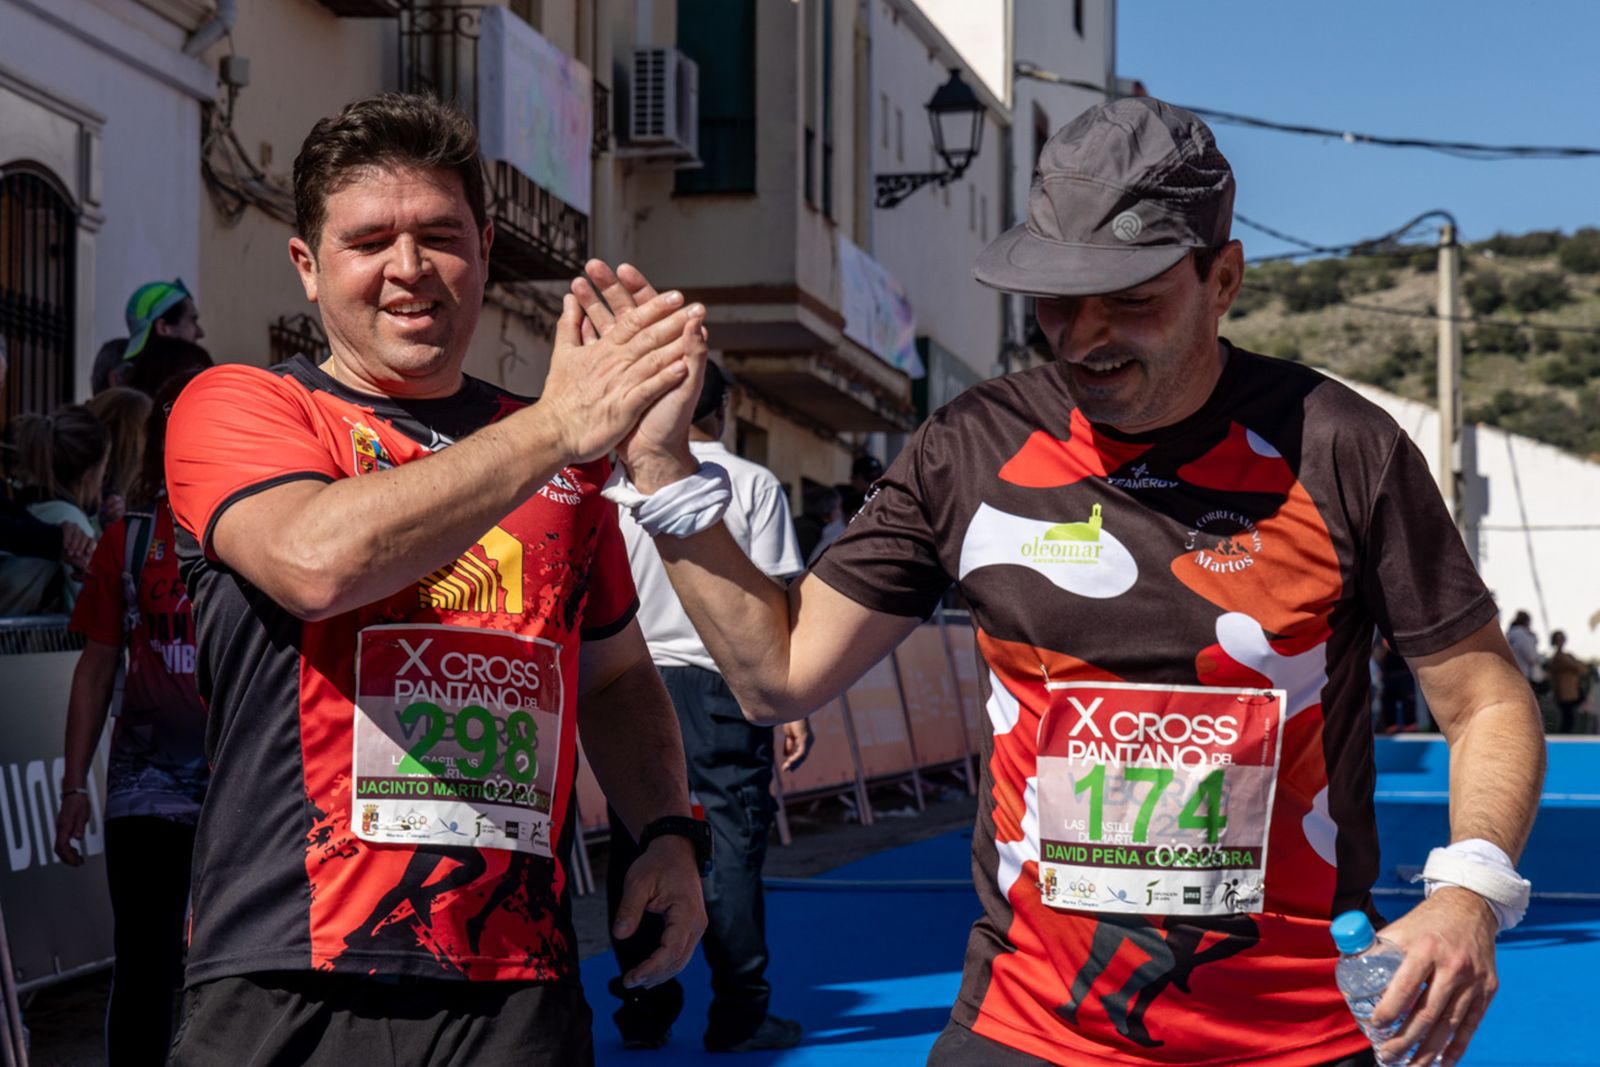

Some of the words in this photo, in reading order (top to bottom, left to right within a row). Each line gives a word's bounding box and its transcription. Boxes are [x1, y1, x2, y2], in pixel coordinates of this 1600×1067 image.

[1020, 536, 1104, 559] oleomar
[1194, 550, 1254, 574] Martos
[395, 638, 434, 676] X
[440, 652, 540, 690] CROSS
[394, 680, 521, 712] PANTANO
[523, 696, 540, 709] DEL
[1066, 696, 1104, 738] X
[1109, 711, 1238, 746] CROSS
[397, 702, 537, 784] 298
[1067, 740, 1207, 777] PANTANO
[1211, 752, 1233, 766] DEL
[357, 781, 429, 796] JACINTO
[1074, 764, 1228, 844] 174
[1064, 819, 1086, 831] LAS
[1045, 844, 1087, 861] DAVID
[1092, 847, 1140, 865] PEÑA
